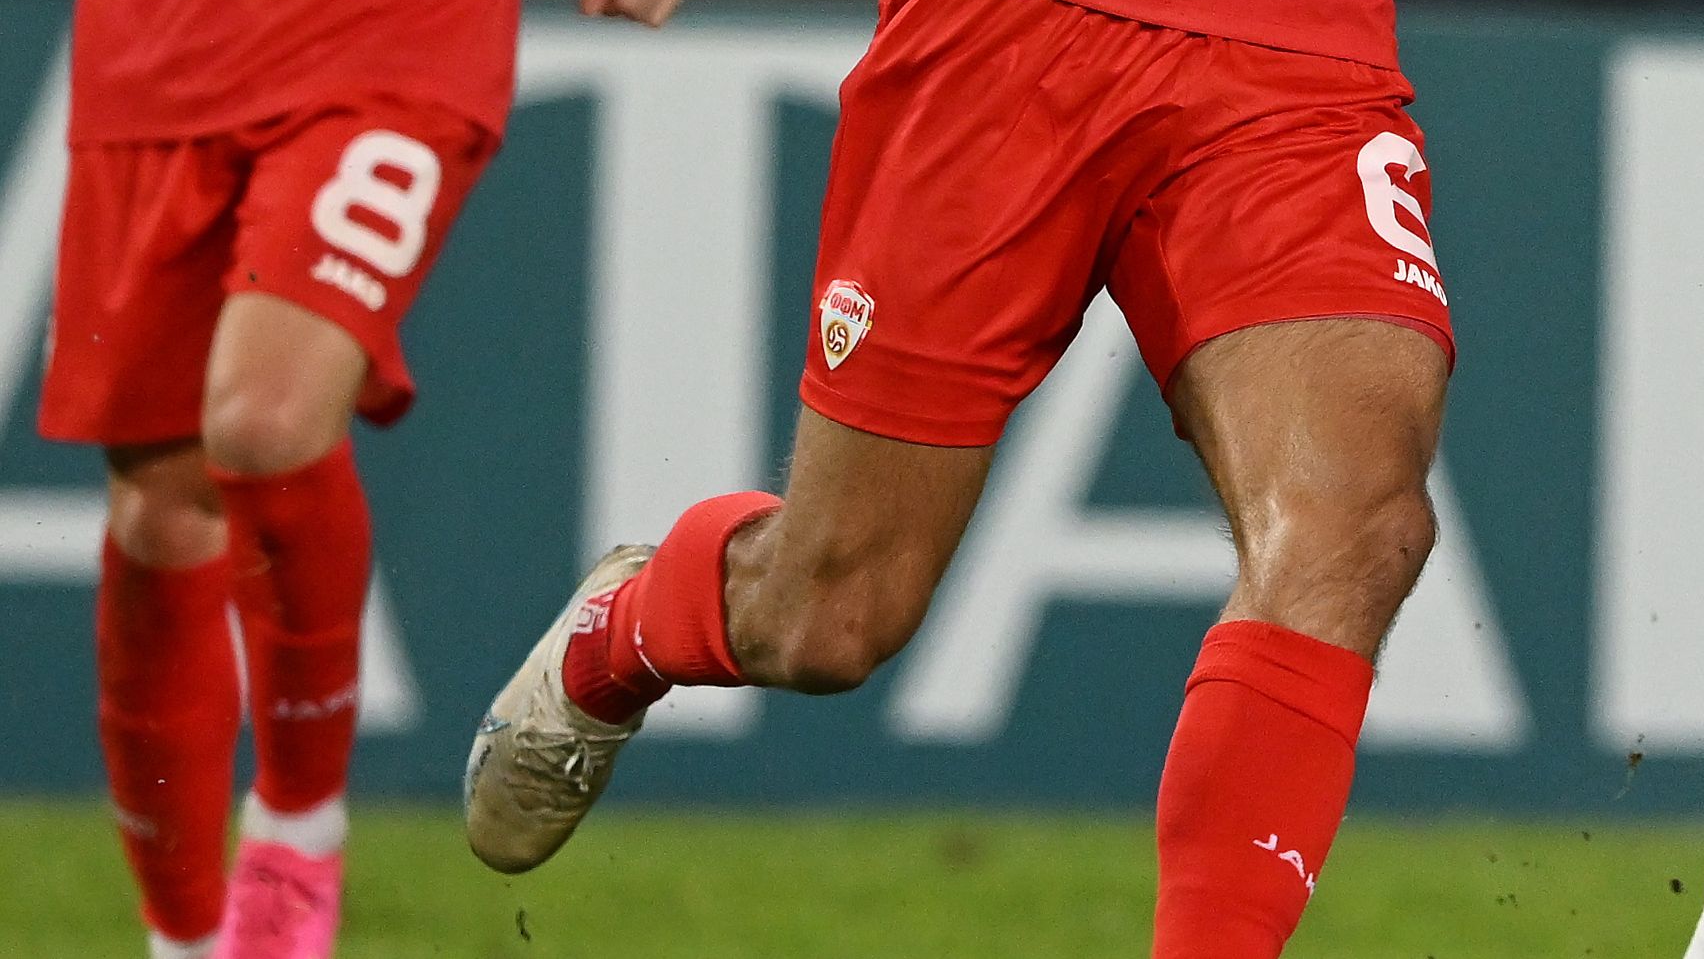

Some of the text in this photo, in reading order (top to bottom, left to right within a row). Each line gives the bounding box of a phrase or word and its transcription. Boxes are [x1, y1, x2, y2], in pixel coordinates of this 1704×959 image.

[311, 128, 442, 278] 8
[1357, 131, 1440, 277] 6
[1394, 259, 1448, 307] JAKO
